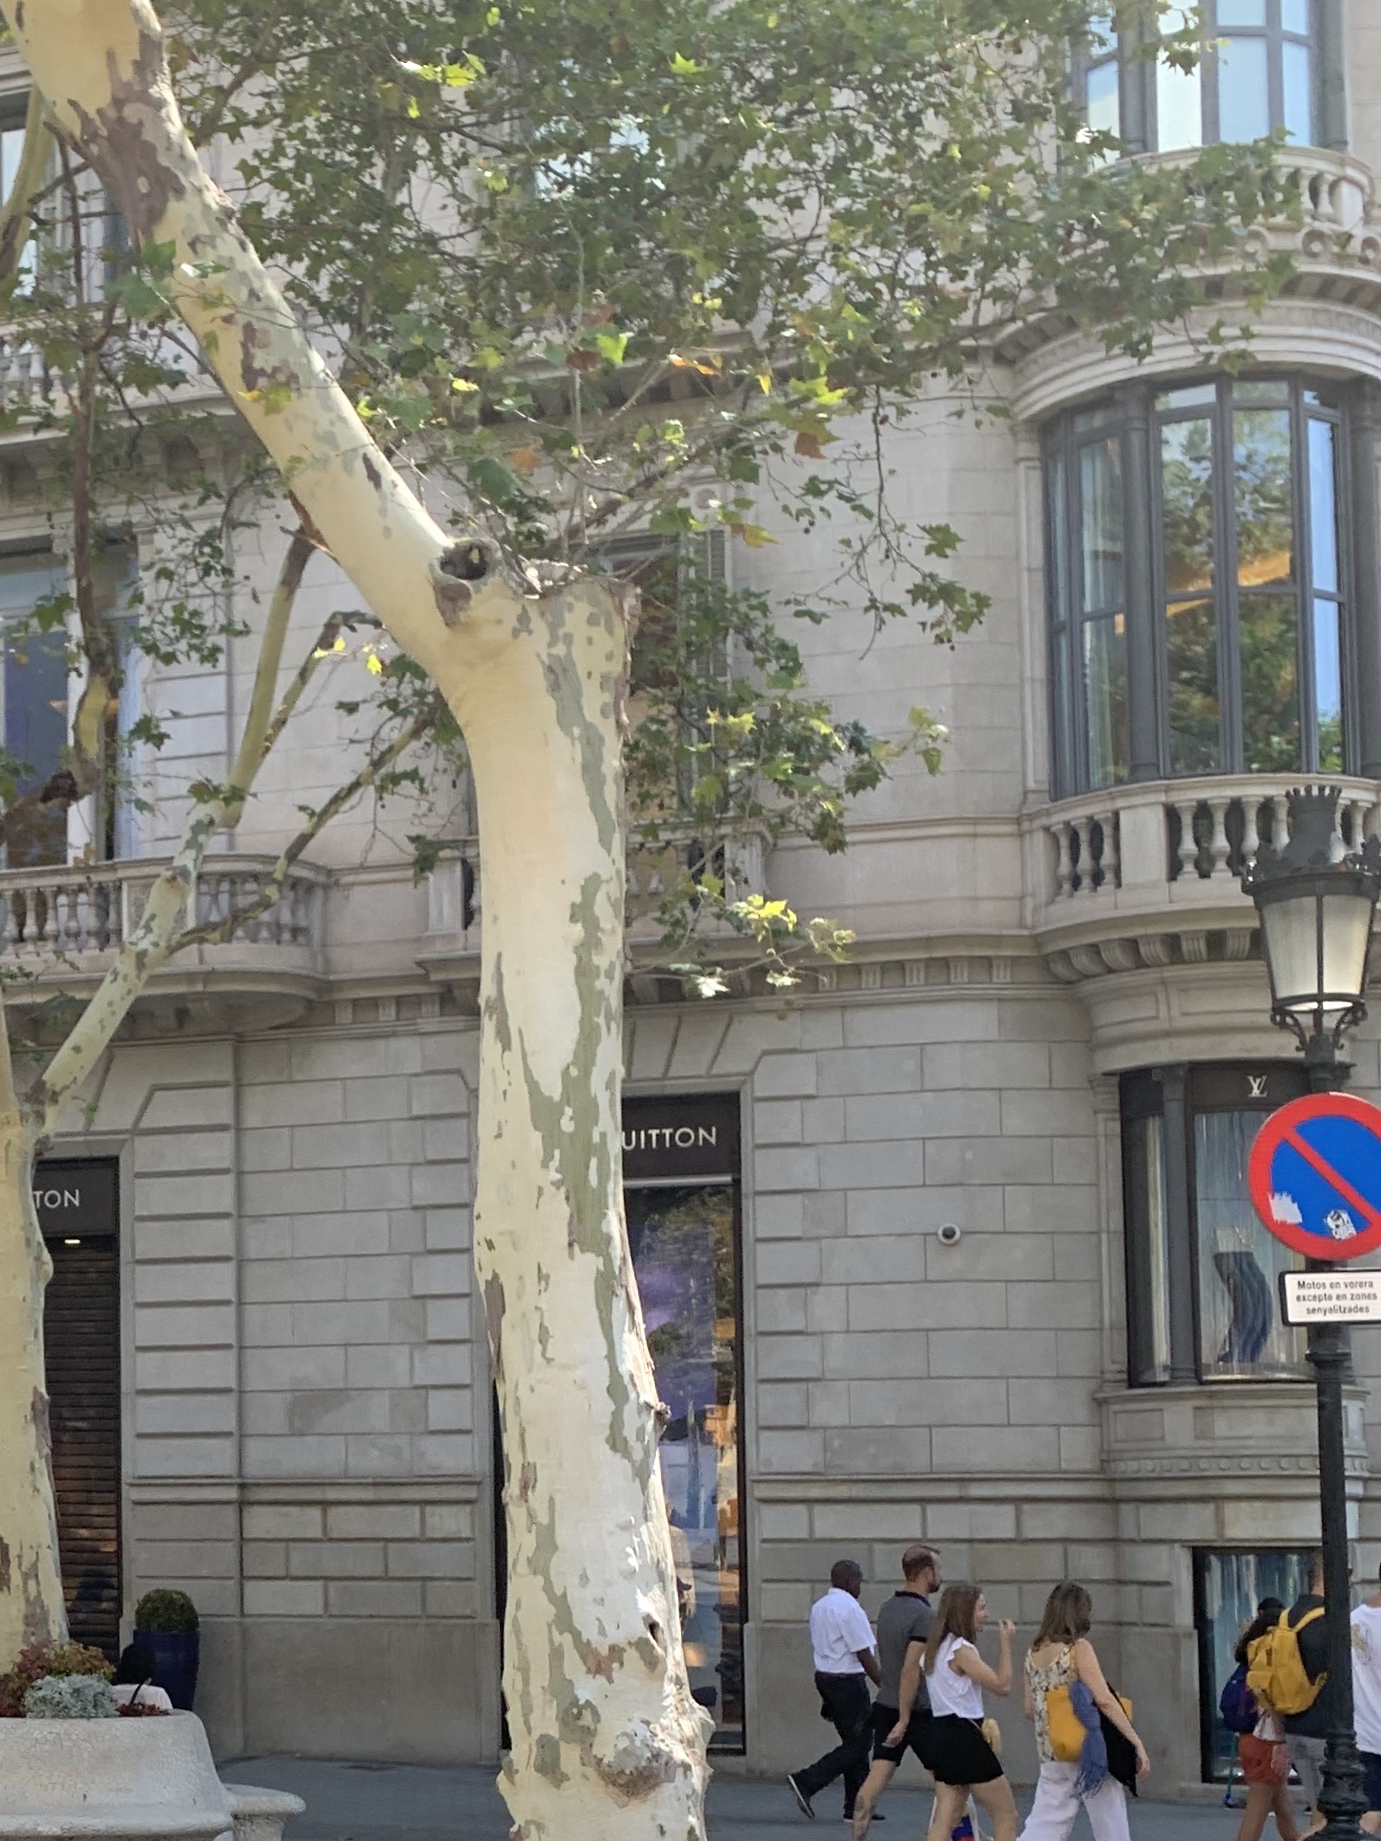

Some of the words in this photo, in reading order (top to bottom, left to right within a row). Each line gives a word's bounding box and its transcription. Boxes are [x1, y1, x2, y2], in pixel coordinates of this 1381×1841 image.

[621, 1125, 717, 1150] UITTON
[1297, 1280, 1327, 1290] Motos
[1329, 1281, 1341, 1289] en
[1343, 1280, 1374, 1289] vorera
[1295, 1293, 1333, 1303] excepte
[1335, 1292, 1347, 1301] en
[1350, 1291, 1378, 1300] zones
[1306, 1304, 1370, 1316] senyalitzades
